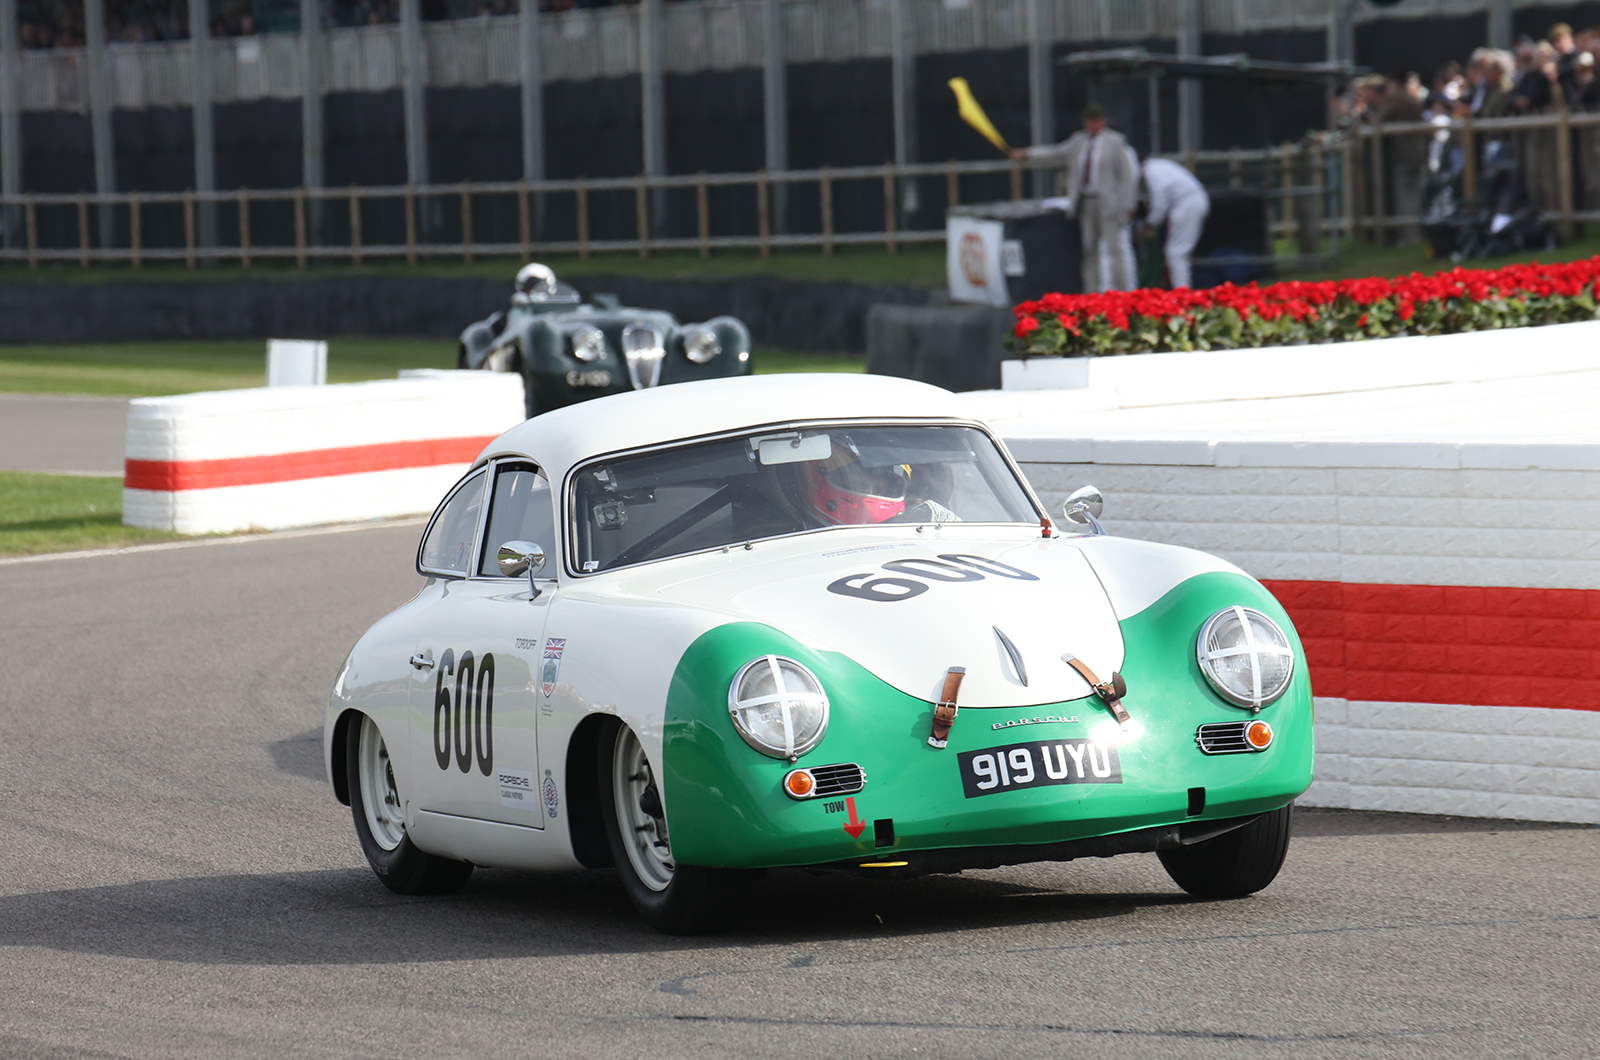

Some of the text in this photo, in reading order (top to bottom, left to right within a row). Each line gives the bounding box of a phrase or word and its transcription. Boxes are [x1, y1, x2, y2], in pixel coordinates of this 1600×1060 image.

[826, 553, 1041, 602] 600
[433, 647, 495, 777] 600
[992, 715, 1079, 730] PORSCHE
[499, 774, 529, 787] PORSCHE
[972, 743, 1112, 790] 919 UYU
[823, 800, 845, 814] TOW
